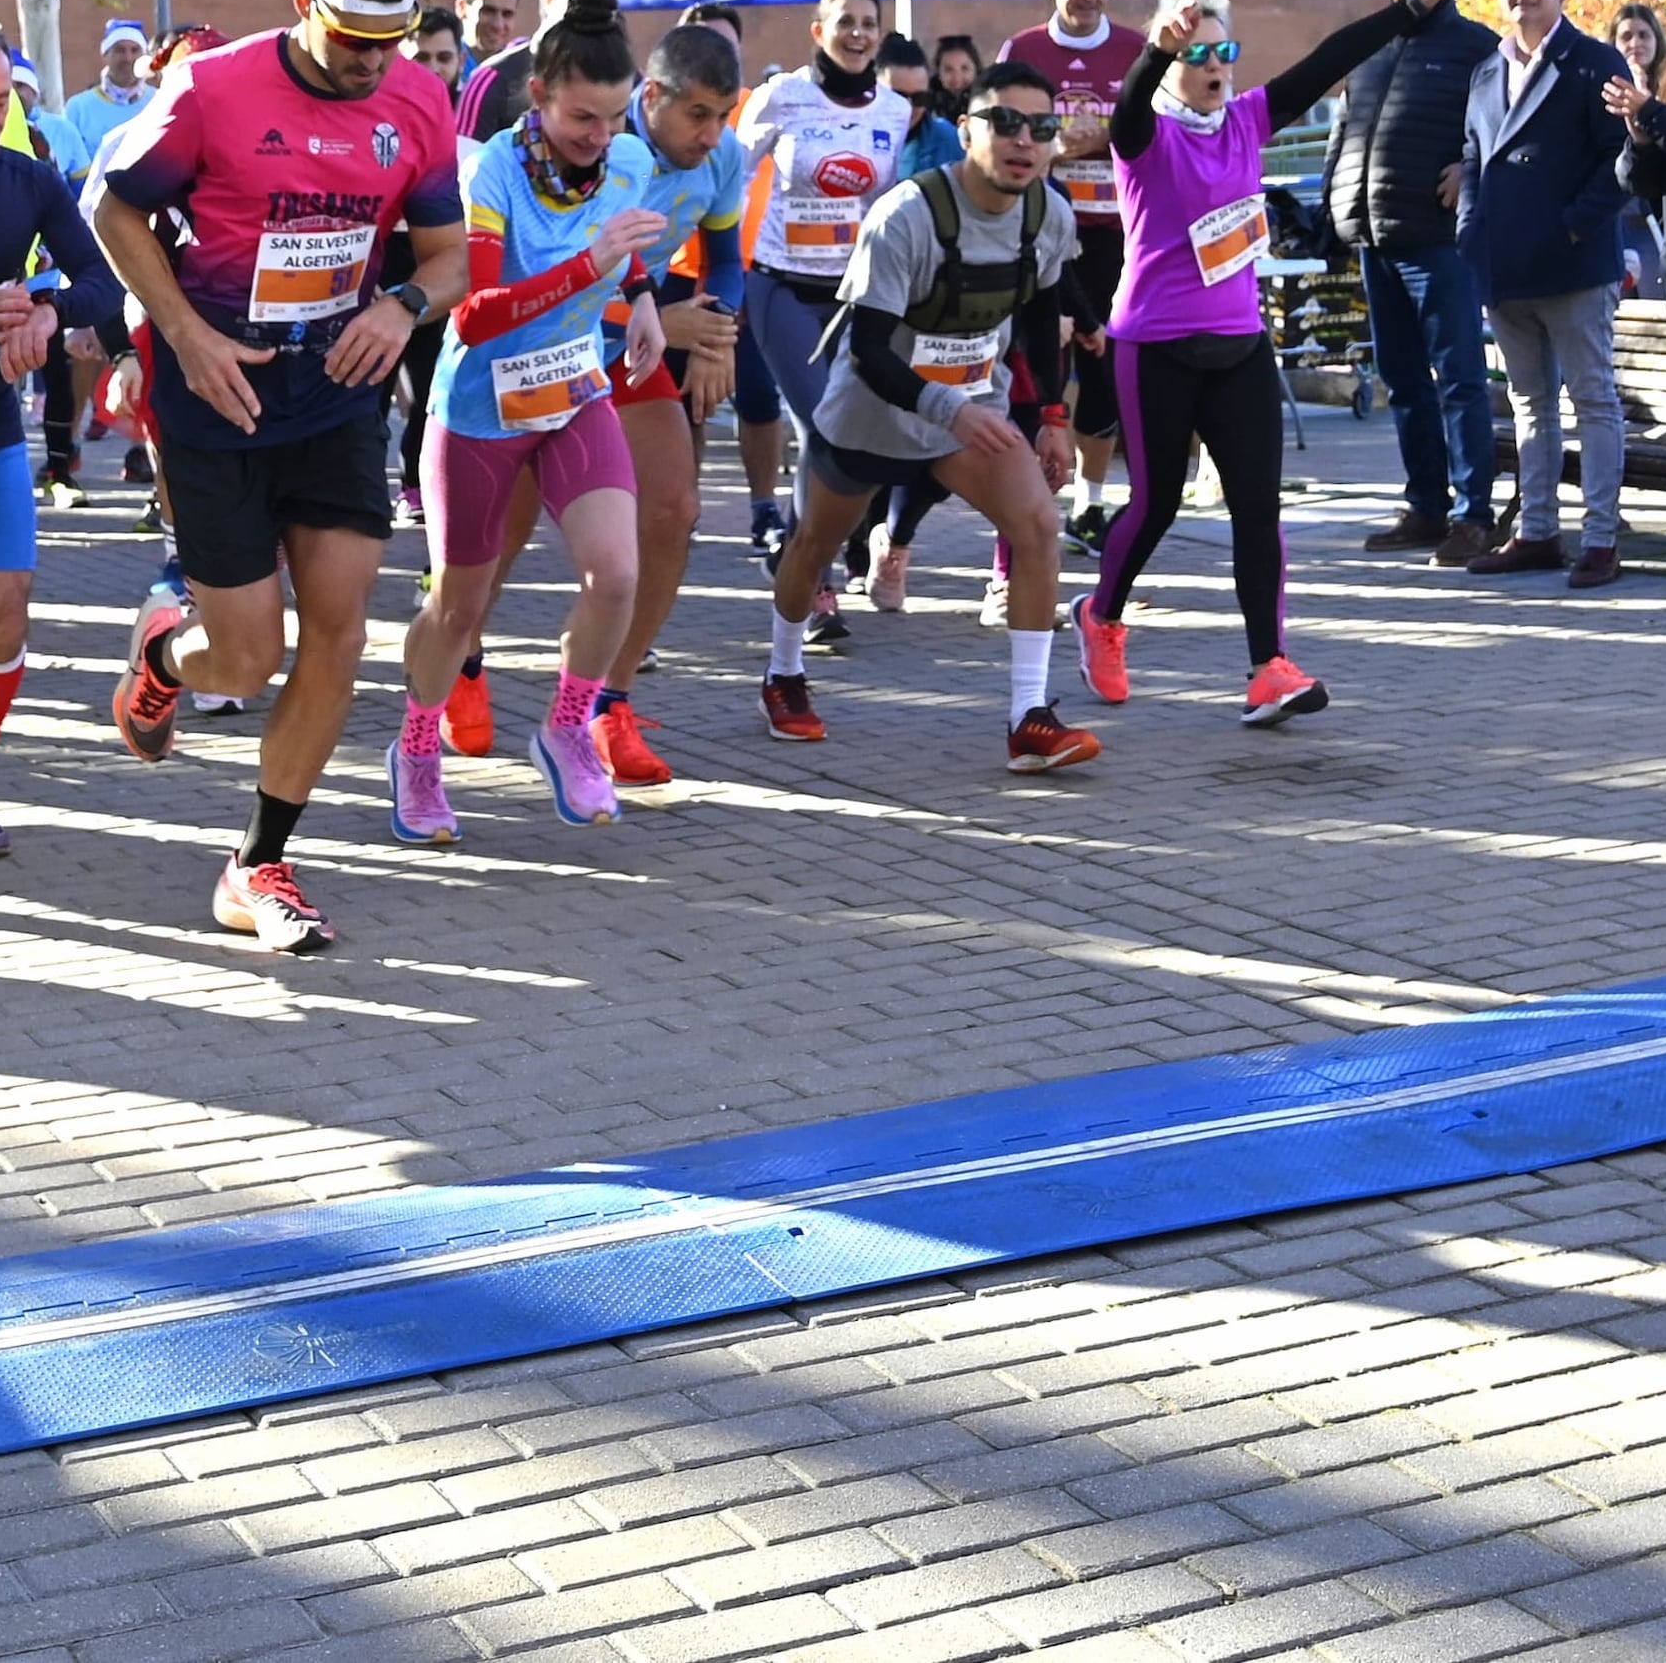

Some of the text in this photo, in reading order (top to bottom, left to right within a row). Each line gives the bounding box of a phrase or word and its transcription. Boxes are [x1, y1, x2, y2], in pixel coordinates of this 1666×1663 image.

[270, 231, 369, 250] SAN SILVESTRE
[284, 248, 353, 268] ALGETEÑA
[501, 340, 590, 374] SAN SILVESTRE
[519, 360, 583, 387] ALGETEÑA
